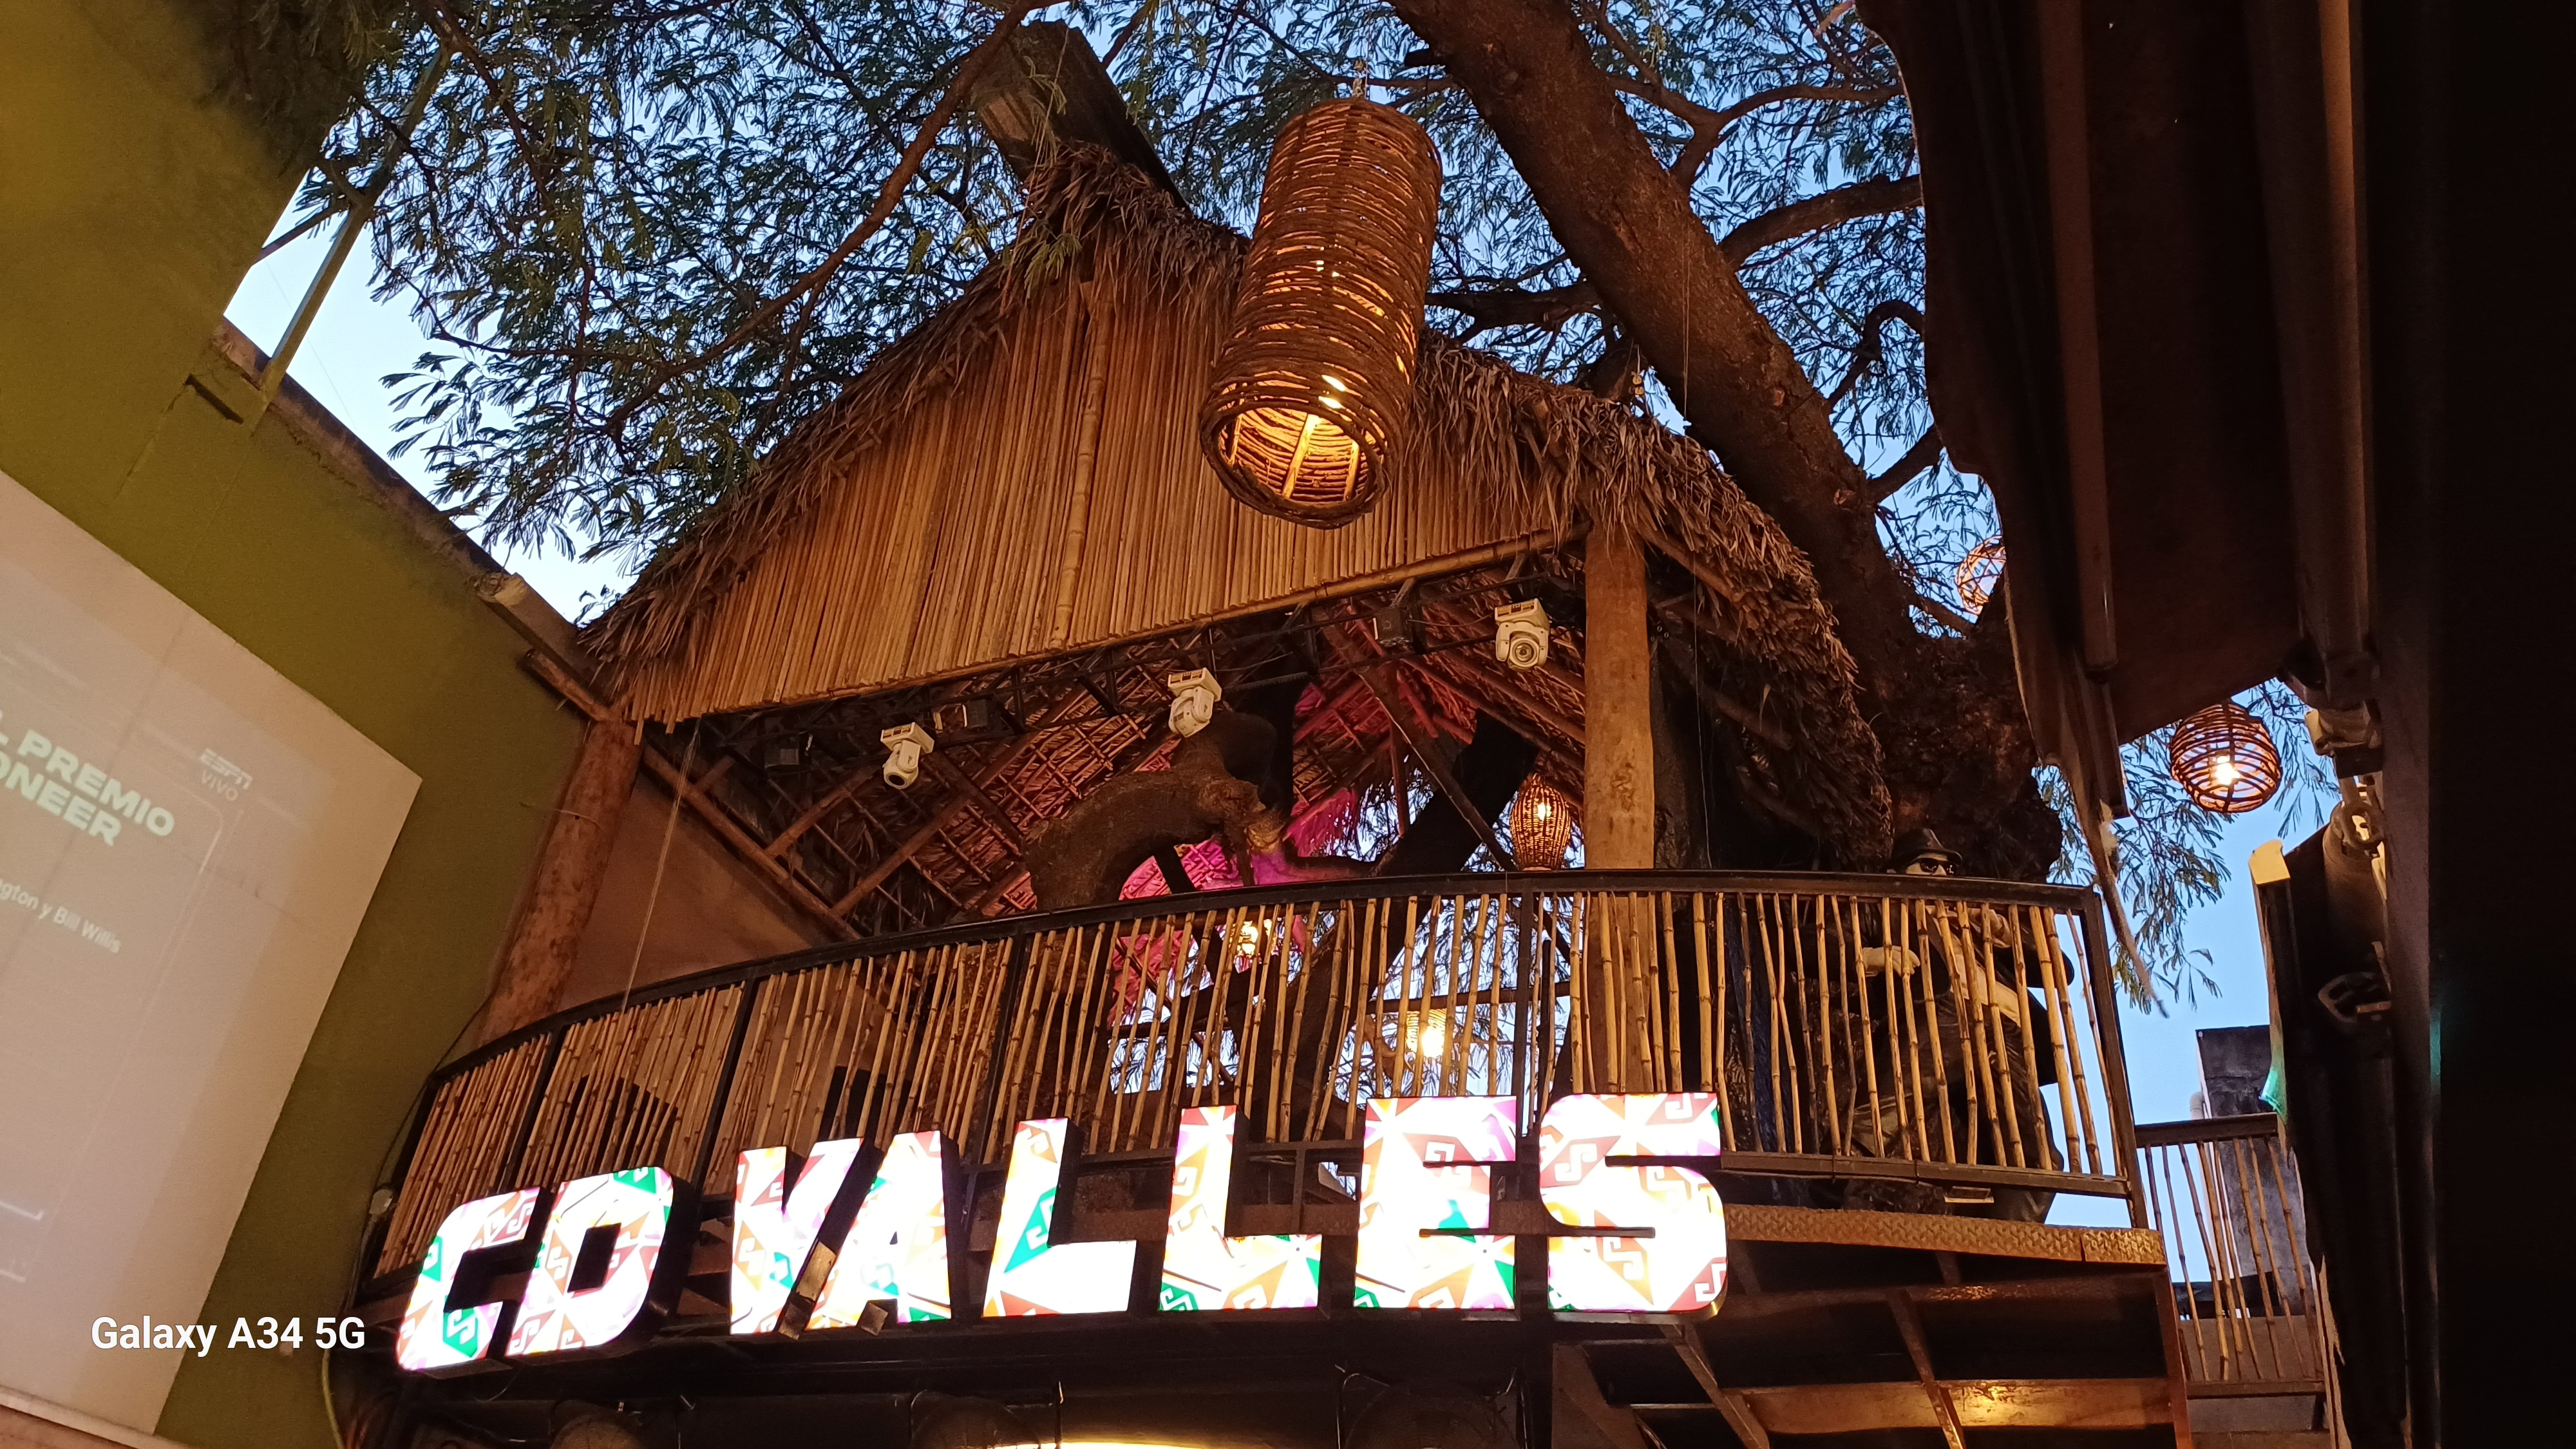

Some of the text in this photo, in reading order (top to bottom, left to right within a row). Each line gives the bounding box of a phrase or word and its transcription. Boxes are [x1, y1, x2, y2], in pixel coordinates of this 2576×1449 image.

[17, 728, 176, 837] PREMIO
[200, 747, 253, 790] ESPN
[202, 769, 239, 802] VIVO
[0, 878, 39, 910] gton
[39, 902, 53, 920] y
[395, 1091, 1728, 1372] CD VALLES
